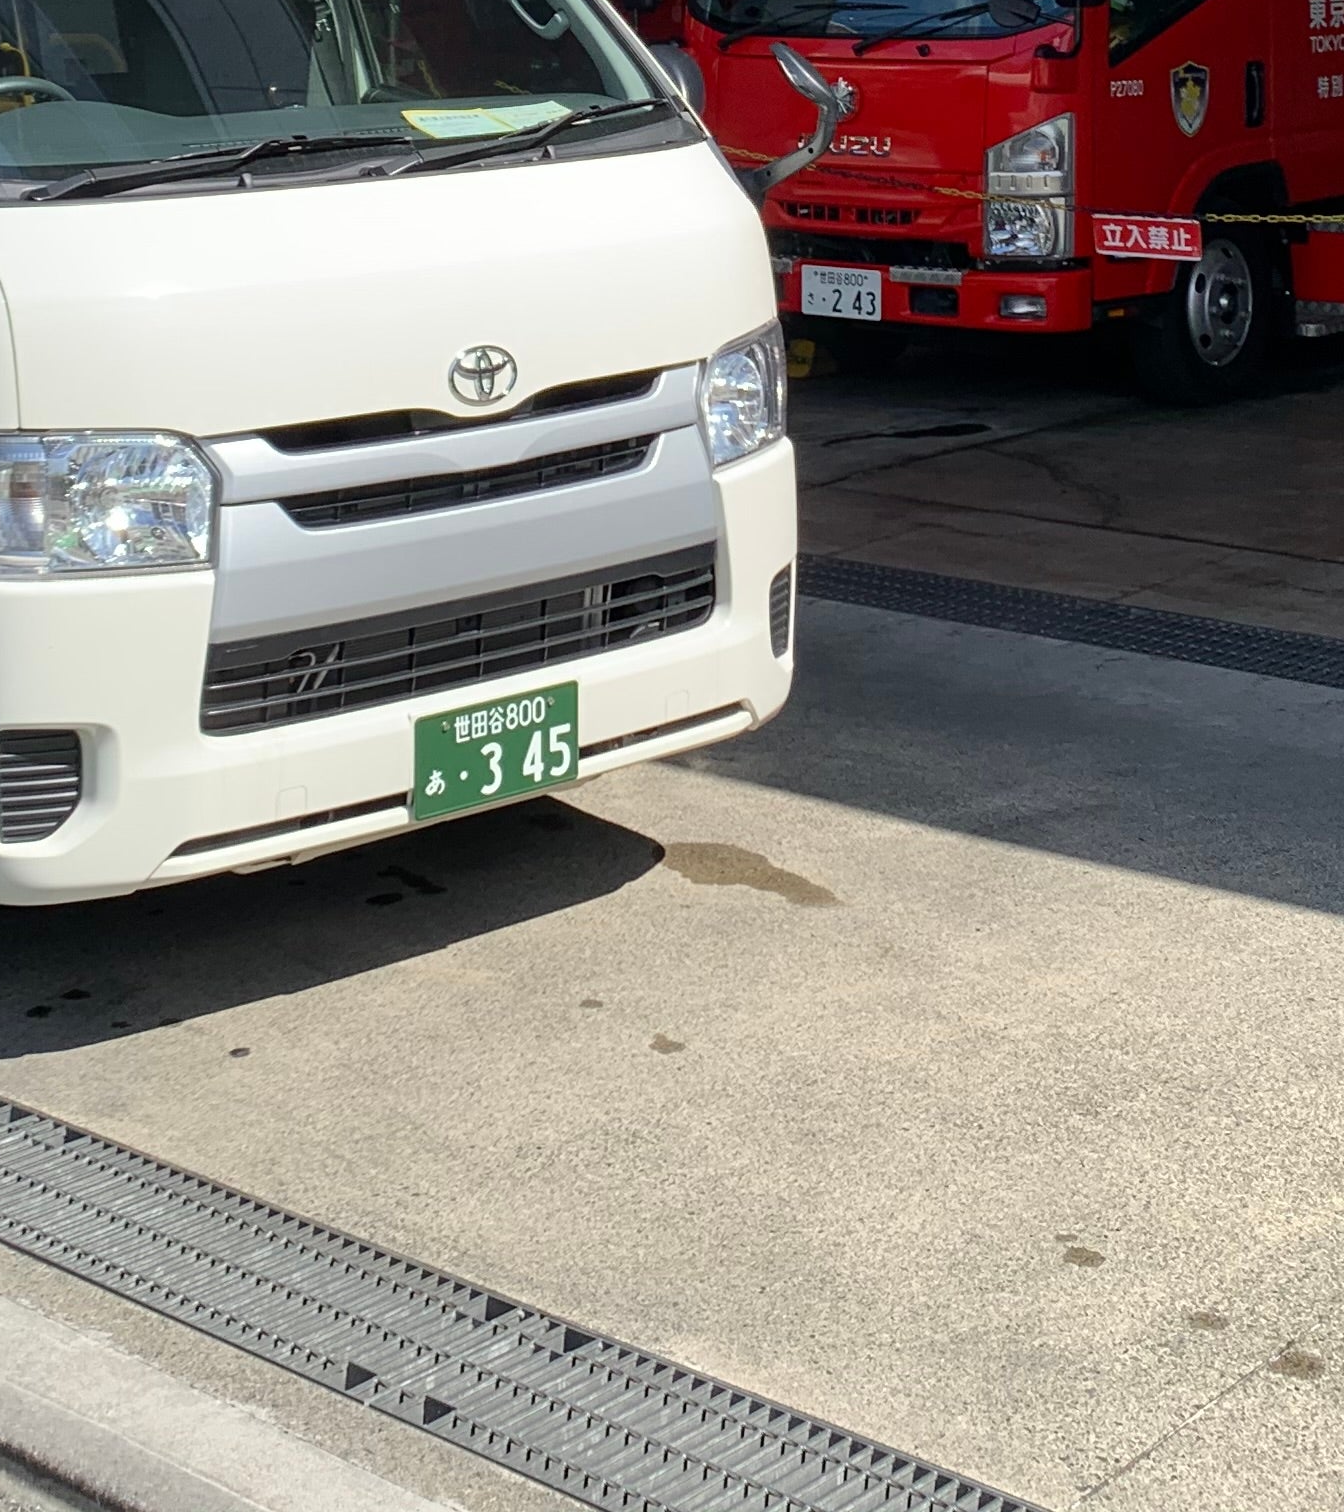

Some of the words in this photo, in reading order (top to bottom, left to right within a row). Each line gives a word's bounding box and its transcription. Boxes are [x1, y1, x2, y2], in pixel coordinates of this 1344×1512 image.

[1109, 79, 1144, 97] P27080
[1102, 223, 1193, 252] 立入禁止
[819, 271, 864, 287] 世田谷800
[453, 695, 546, 744] 世田谷800
